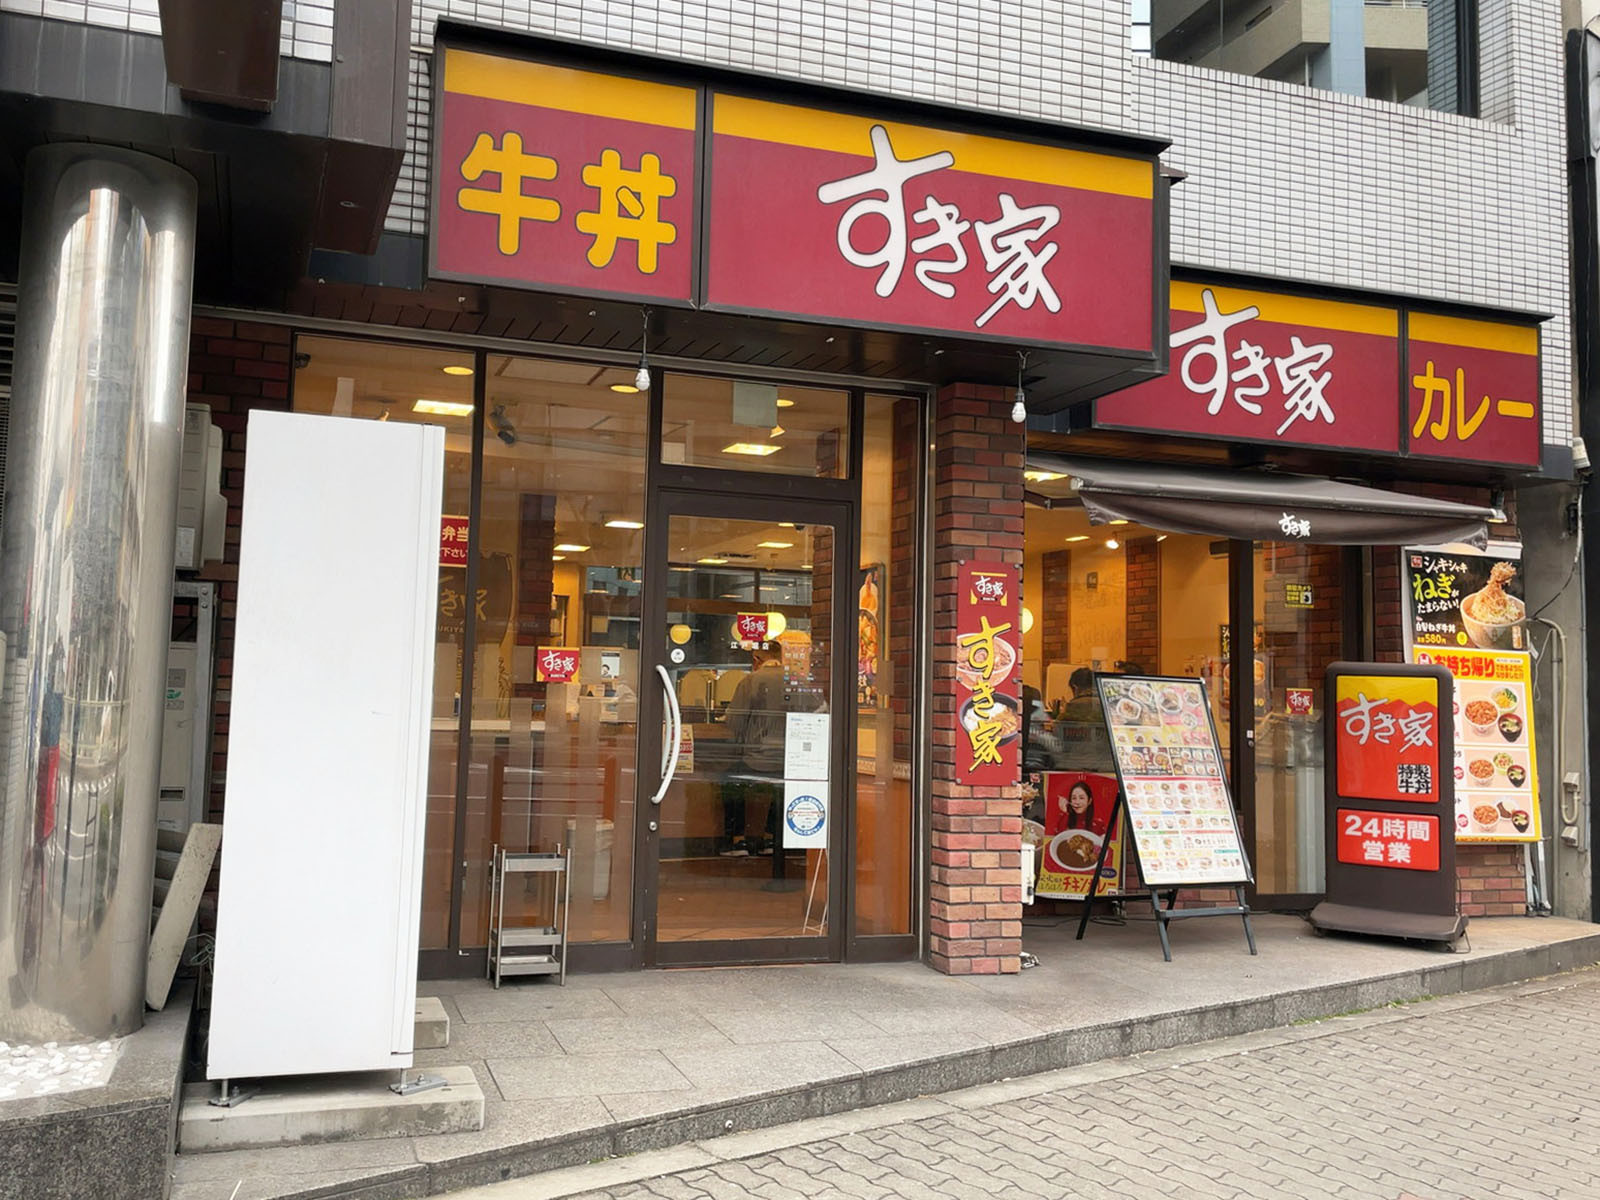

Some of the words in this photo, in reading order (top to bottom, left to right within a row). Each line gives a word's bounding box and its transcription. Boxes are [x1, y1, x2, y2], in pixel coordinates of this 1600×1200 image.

[457, 131, 678, 275] 牛丼
[816, 124, 1061, 329] すき家
[1169, 288, 1336, 436] すき家
[1412, 361, 1535, 441] カレー
[1278, 512, 1311, 539] すき家
[1424, 556, 1468, 573] シャキシャキ
[975, 575, 1004, 598] すき家
[740, 615, 766, 634] すき家
[541, 650, 575, 674] すき家
[961, 615, 1013, 773] すき家
[1340, 693, 1434, 753] すき家
[1345, 815, 1430, 842] 24時間
[1362, 840, 1411, 864] 営業
